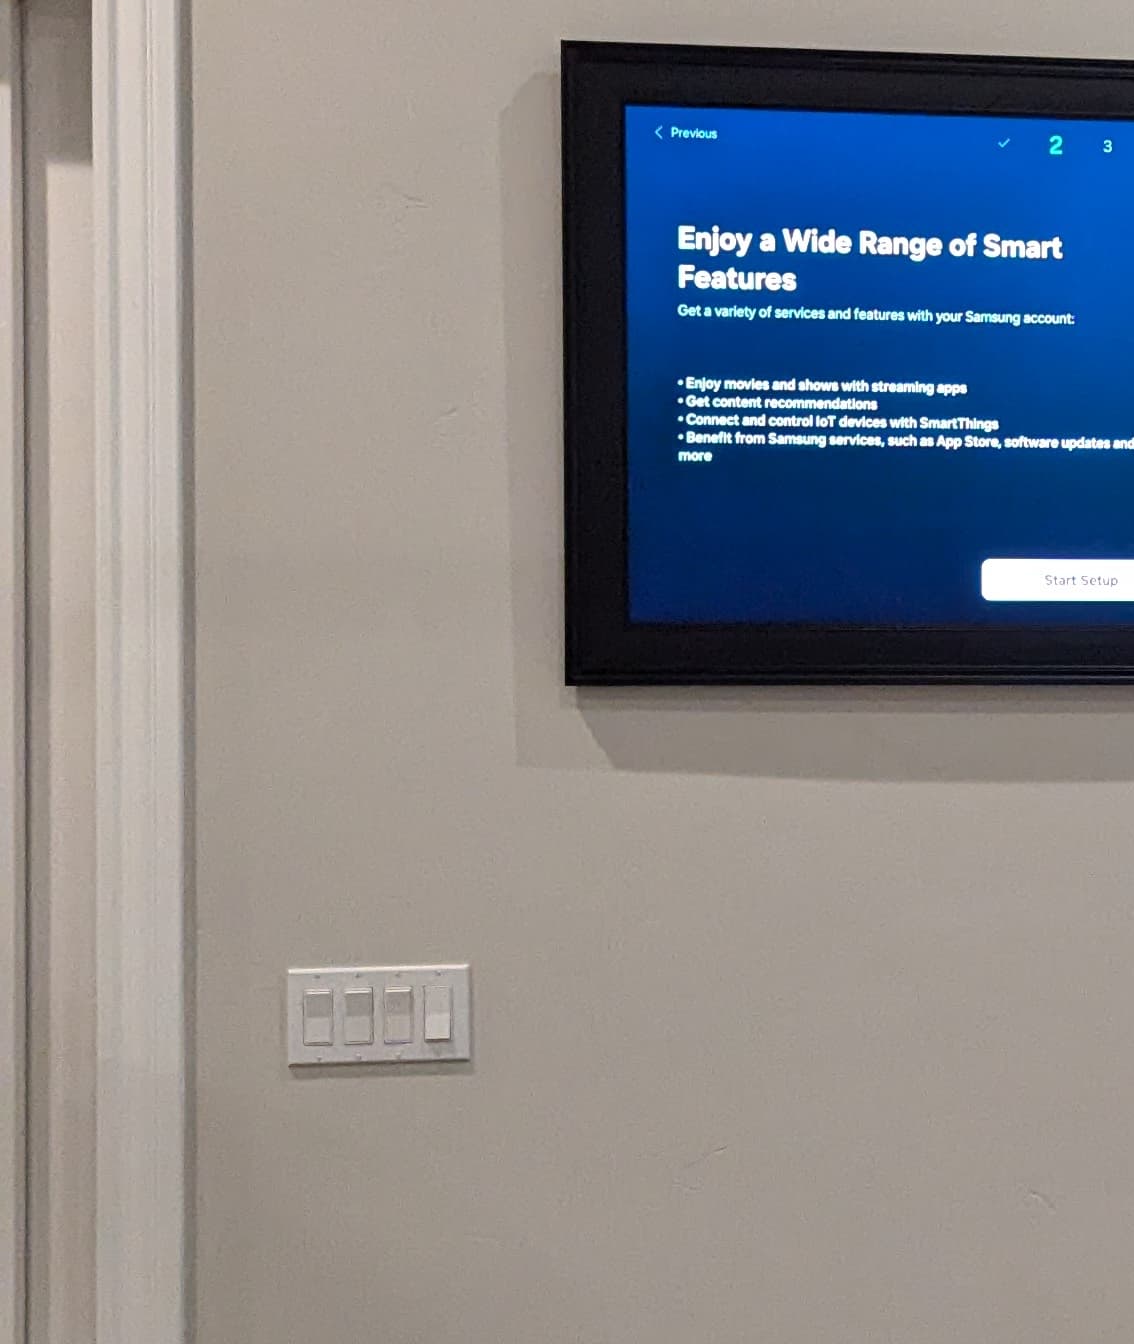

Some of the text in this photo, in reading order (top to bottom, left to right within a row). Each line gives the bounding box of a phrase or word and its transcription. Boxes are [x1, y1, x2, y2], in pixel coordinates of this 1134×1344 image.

[671, 126, 718, 139] Previous
[1049, 135, 1063, 156] 2
[1103, 139, 1113, 154] 3
[678, 225, 1063, 262] Enjoy a Wide Range of Smart
[678, 264, 798, 291] Features
[677, 304, 1076, 327] Get a variety of services and features with your Samsung account:
[685, 376, 968, 397] Enjoy movies and shows with streaming apps
[685, 395, 878, 411] Get content recommendations
[686, 413, 740, 427] Connect
[742, 414, 766, 427] and
[768, 414, 813, 428] control
[838, 416, 887, 429] devices
[889, 416, 917, 430] with
[919, 417, 999, 432] SmartThings
[686, 431, 733, 444] Benefit
[734, 431, 766, 445] from
[767, 432, 827, 448] Samsung
[828, 434, 886, 448] services,
[887, 434, 918, 448] such
[919, 437, 934, 448] as
[935, 435, 962, 450] App
[964, 435, 1002, 450] Store,
[1004, 436, 1059, 449] software
[1060, 437, 1111, 451] updates
[677, 450, 713, 462] more
[1045, 575, 1119, 588] Start Setup
